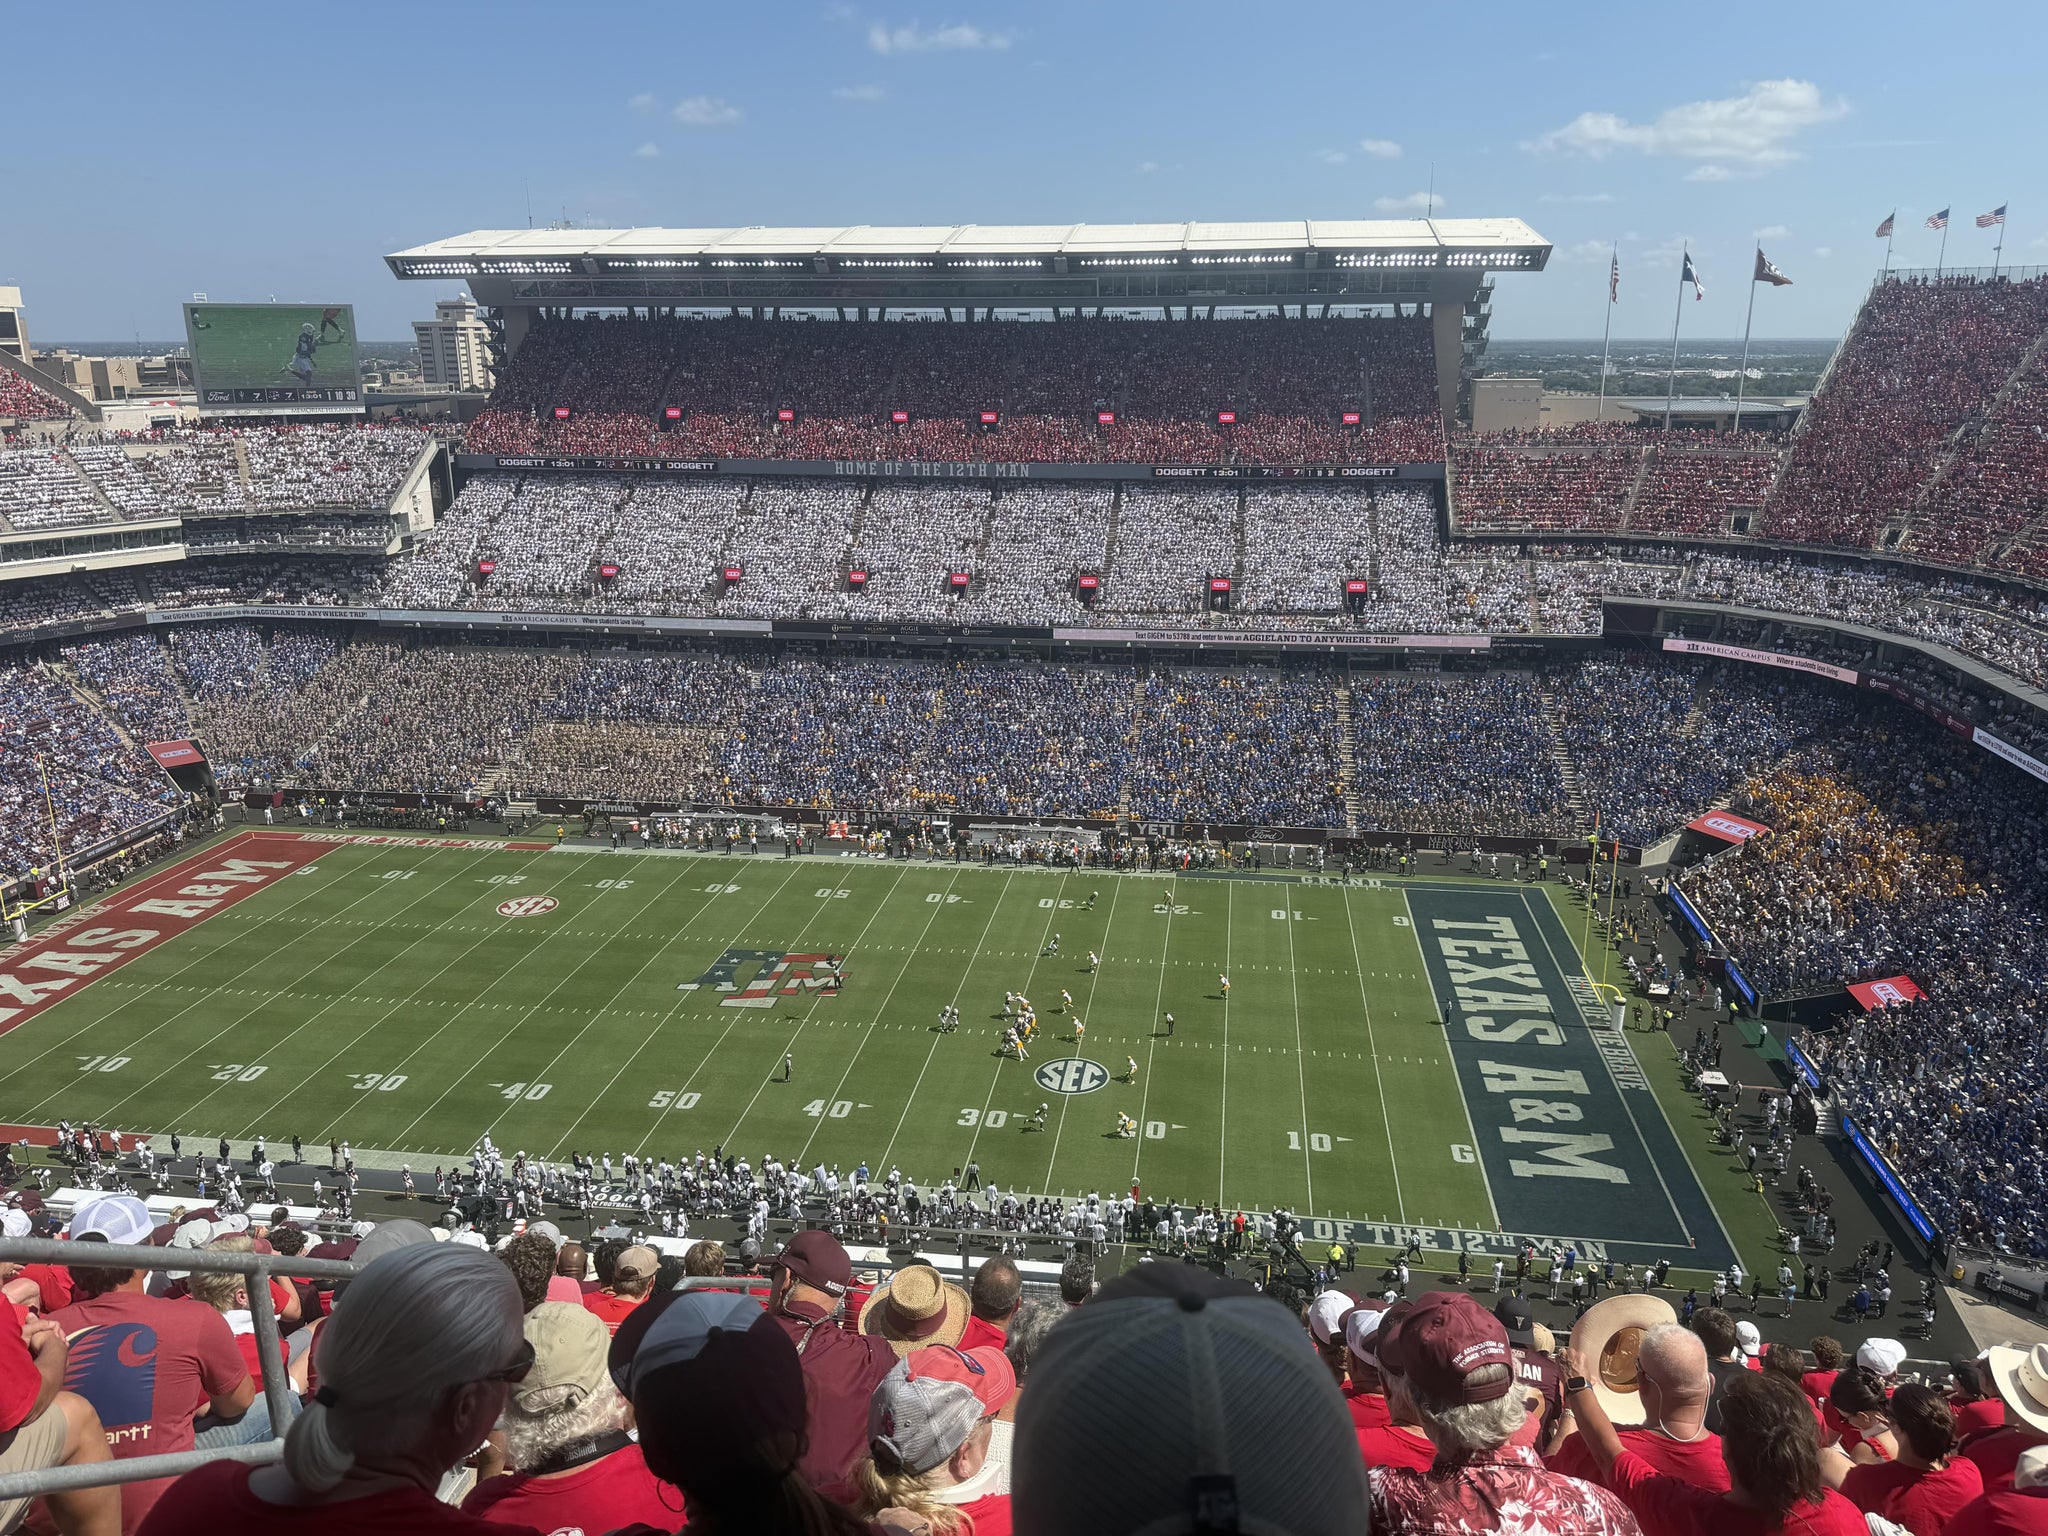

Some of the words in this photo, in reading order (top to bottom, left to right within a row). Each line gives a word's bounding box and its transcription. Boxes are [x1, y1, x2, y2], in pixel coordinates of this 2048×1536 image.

[208, 391, 230, 401] Ford
[253, 392, 261, 400] 7
[285, 391, 292, 399] 7
[327, 391, 332, 401] 1
[335, 391, 344, 401] 10
[345, 391, 356, 401] 30
[499, 458, 546, 466] DOGGETT
[666, 461, 715, 470] DOGGETT
[834, 461, 877, 475] HOME
[884, 461, 903, 475] OF
[911, 462, 941, 476] THE
[949, 463, 988, 477] 12TH
[995, 463, 1030, 478] MAN
[1155, 468, 1207, 476] DOGGETT
[1262, 468, 1269, 476] 7
[1293, 468, 1300, 476] 7
[1341, 468, 1396, 476] DOGGETT
[172, 612, 190, 620] GIGEM
[307, 610, 348, 618] ANYWHERE
[550, 616, 577, 624] CAMPUS
[582, 616, 598, 624] Where
[599, 617, 620, 625] students
[620, 618, 631, 626] love
[1135, 632, 1147, 640] Text
[1147, 632, 1166, 640] GIGEM
[1166, 632, 1173, 640] to
[1173, 632, 1191, 640] 53788
[1243, 634, 1298, 643] AGGIELAND
[1300, 635, 1313, 643] TO
[1314, 635, 1372, 644] ANYWHERE
[1374, 636, 1400, 645] TRIP!
[1701, 645, 1740, 656] AMERICAN
[1741, 651, 1771, 662] CAMPUS
[1776, 656, 1794, 666] Where
[1795, 659, 1817, 670] students
[1817, 663, 1826, 673] love
[373, 796, 396, 804] Gemini
[817, 810, 857, 823] TEXAS
[864, 811, 888, 823] A&M
[1136, 823, 1176, 836] YETI
[1251, 828, 1277, 840] Ford
[297, 832, 347, 843] HOME
[383, 836, 418, 846] THE
[463, 839, 508, 850] MAN
[1428, 835, 1480, 844] MEMORIAL
[126, 858, 295, 918] A&M
[815, 887, 852, 899] 50
[57, 895, 69, 905] SEAT
[57, 900, 70, 911] GEEK
[925, 892, 963, 904] 40
[1038, 898, 1075, 909] 30
[502, 897, 556, 916] SEC
[0, 926, 161, 1024] XAS
[1431, 915, 1568, 1046] TEXAS
[1565, 975, 1601, 1006] HOME
[1601, 1047, 1649, 1091] BRAVE
[79, 1056, 132, 1072] 10
[210, 1063, 269, 1082] 20
[1041, 1059, 1103, 1092] SEC
[353, 1073, 409, 1091] 30
[500, 1082, 553, 1101] 40
[648, 1090, 702, 1110] 50
[802, 1099, 854, 1119] 40
[956, 1107, 1008, 1129] 30
[1477, 1059, 1631, 1185] A&M
[1287, 1131, 1332, 1153] 10
[1450, 1143, 1476, 1164] G
[1896, 1192, 1910, 1207] BEEF
[1313, 1219, 1351, 1242] OF
[1365, 1223, 1438, 1248] THE
[1447, 1229, 1517, 1254] 12TH
[1525, 1235, 1612, 1262] MAN
[1452, 1353, 1464, 1364] THE
[1463, 1340, 1497, 1355] ASSOCIATION
[1497, 1341, 1505, 1349] OF
[1459, 1352, 1480, 1368] FORMER
[1480, 1347, 1505, 1357] STUDENTS
[1517, 1363, 1543, 1382] AN
